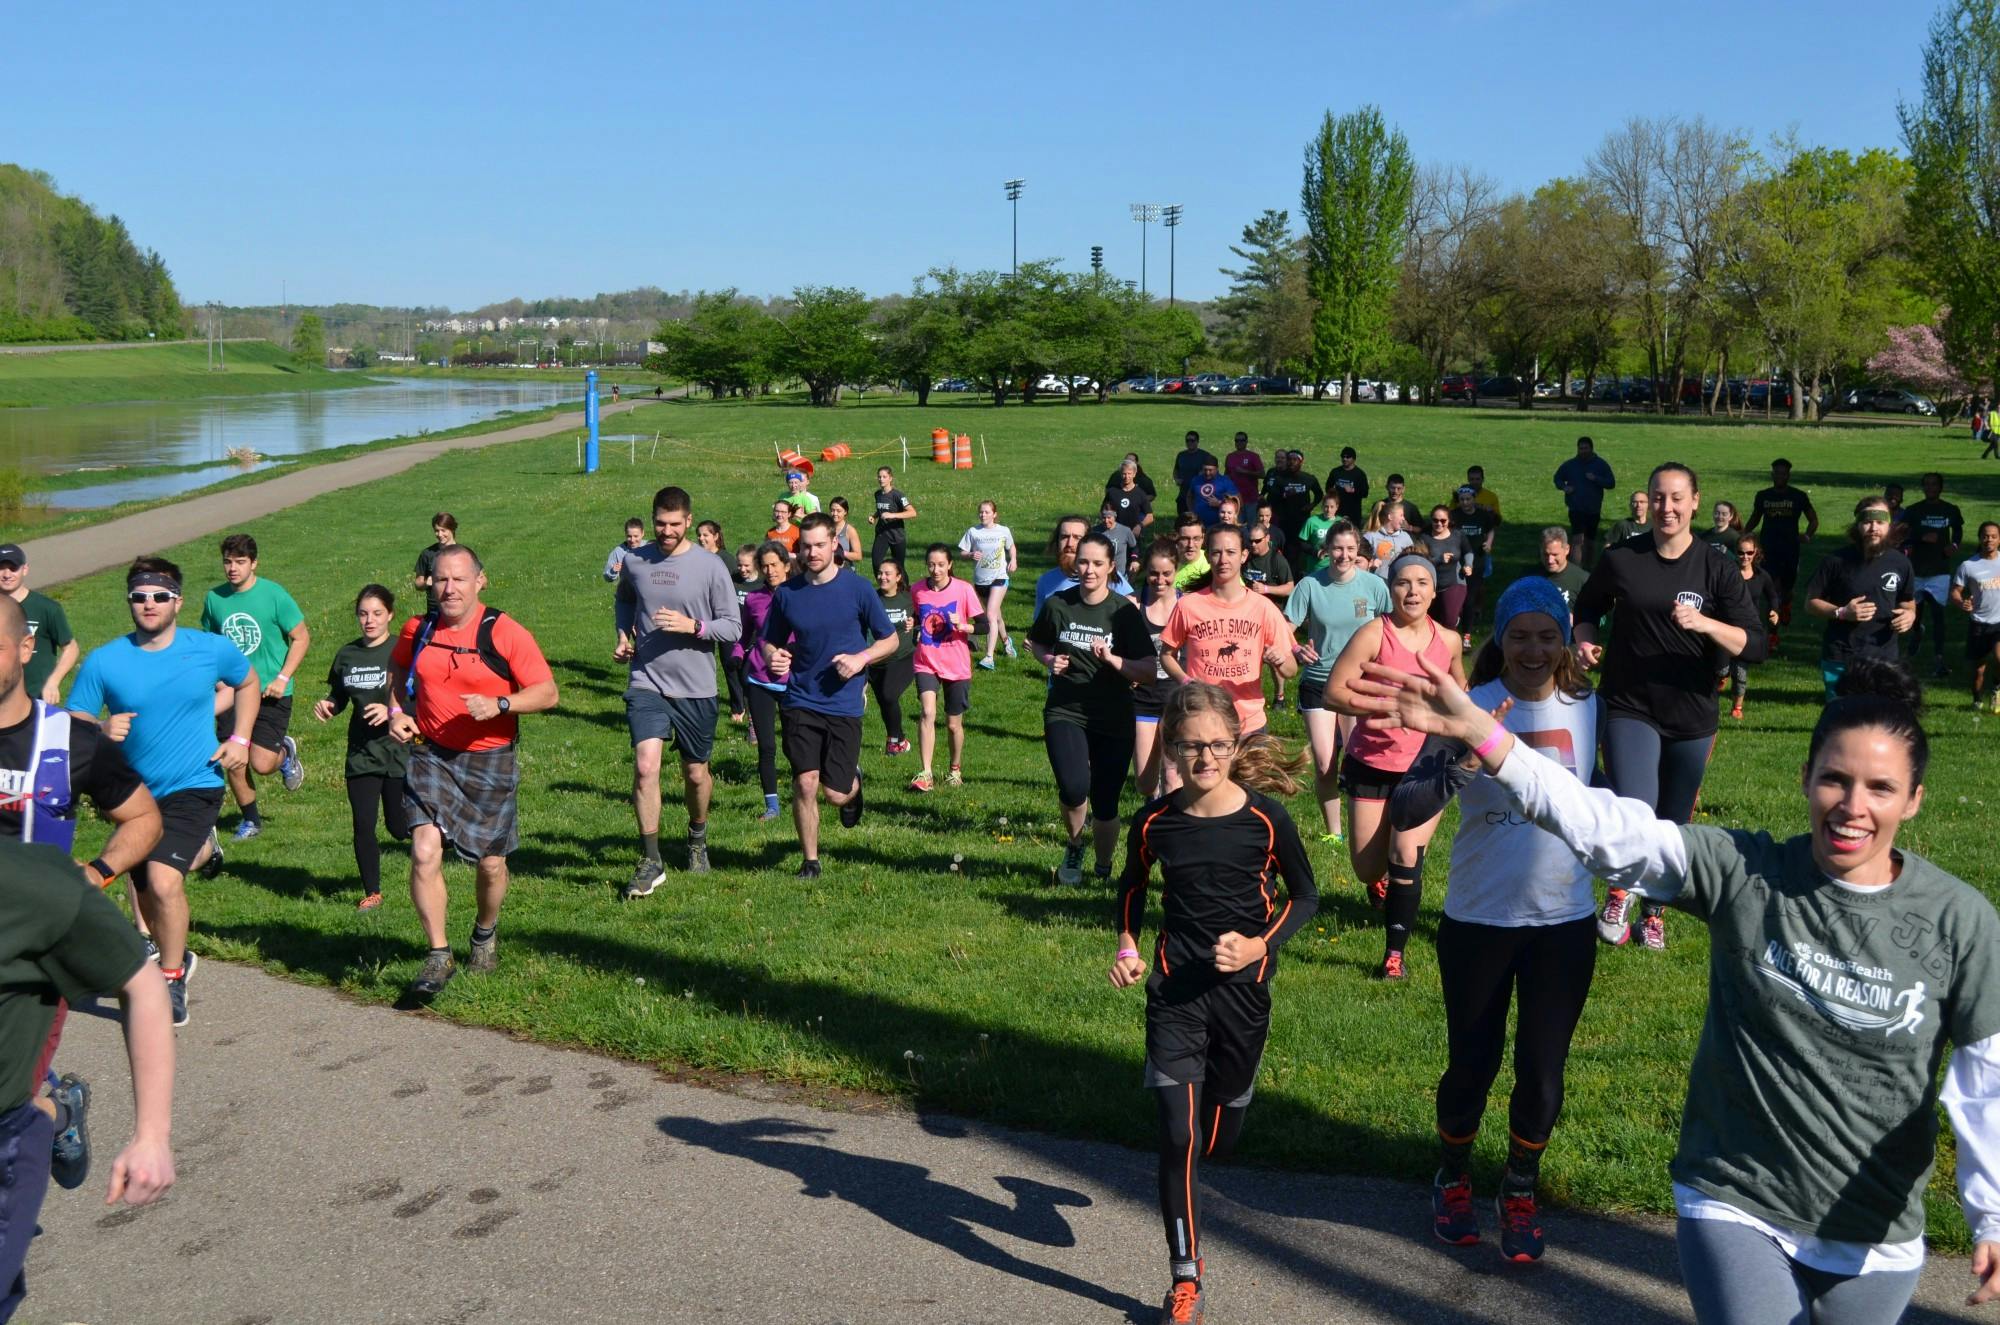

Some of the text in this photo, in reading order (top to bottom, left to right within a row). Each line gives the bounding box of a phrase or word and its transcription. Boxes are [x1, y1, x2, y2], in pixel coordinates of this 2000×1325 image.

[1070, 632, 1080, 642] FOR
[1195, 618, 1261, 639] GREAT SMOKY
[1200, 649, 1252, 657] 19 34
[1203, 663, 1250, 678] TENNESSEE
[1764, 940, 1795, 974] RACE
[1795, 958, 1821, 989] FOR
[1821, 971, 1832, 994] A
[1835, 975, 1892, 1011] REASON
[1814, 951, 1893, 982] OhioHealth
